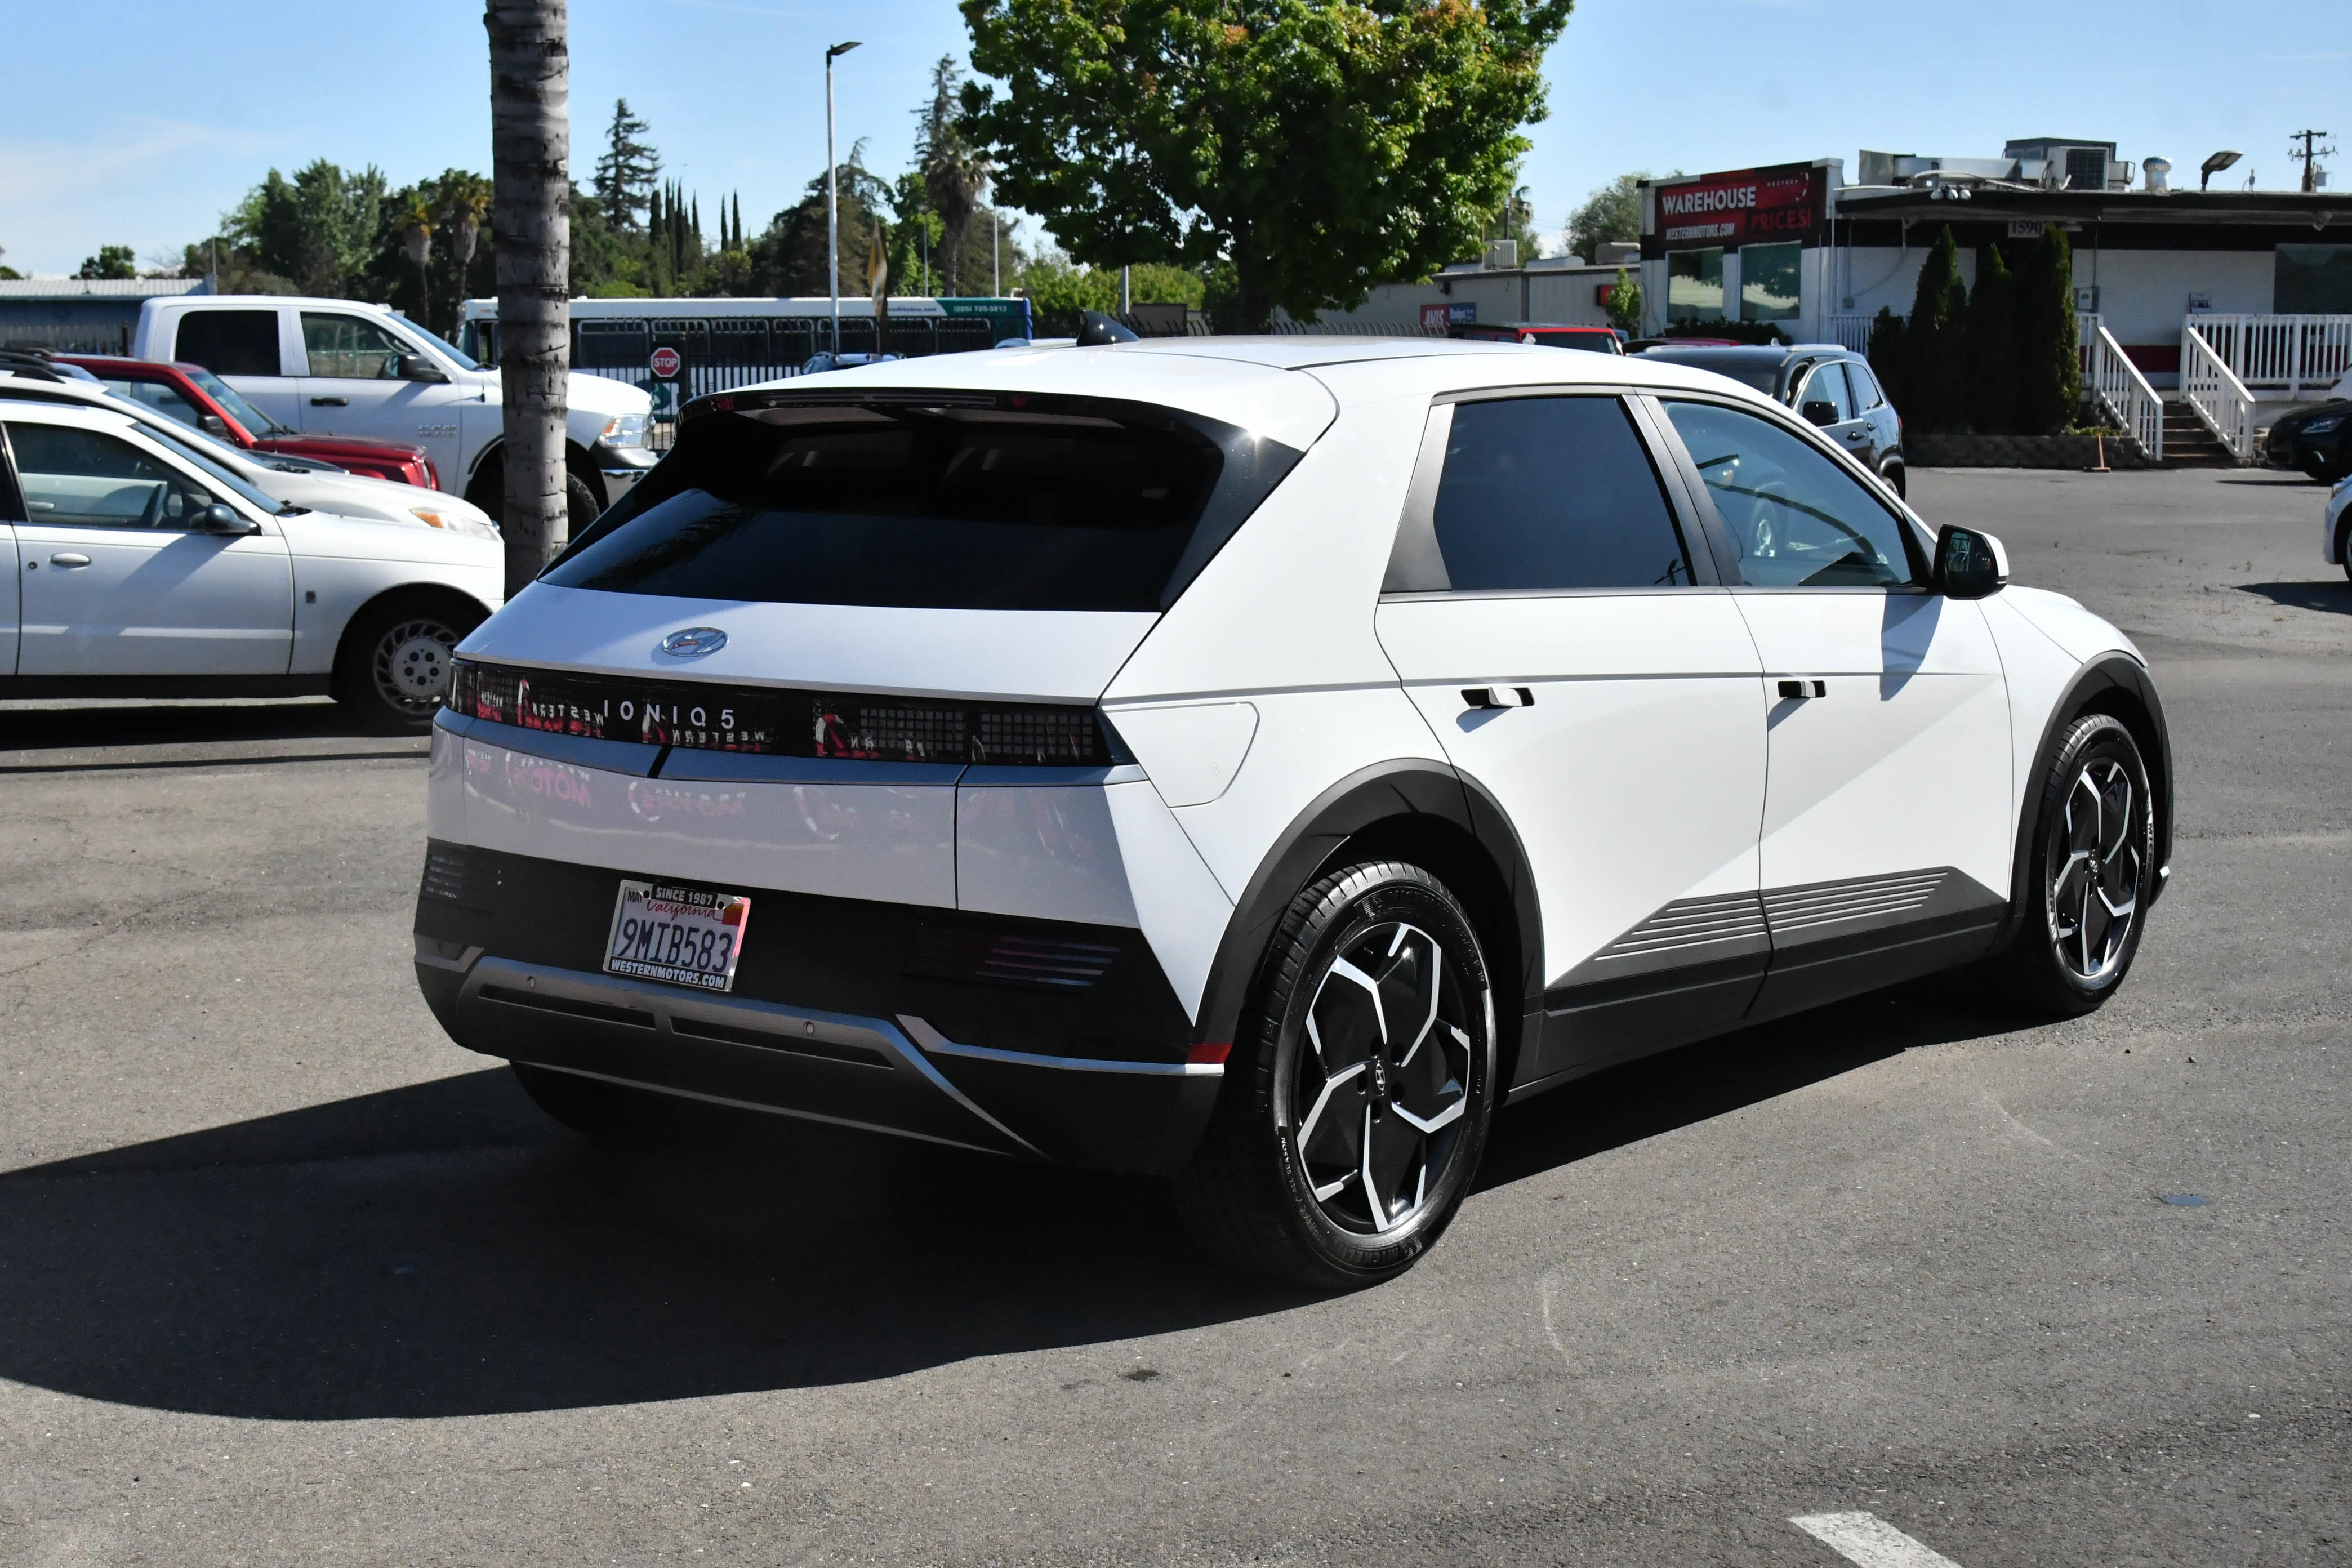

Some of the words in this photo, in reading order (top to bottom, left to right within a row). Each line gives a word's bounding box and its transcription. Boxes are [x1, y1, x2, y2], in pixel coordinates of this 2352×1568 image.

[1663, 186, 1756, 215] WAREHOUSE
[1426, 309, 1444, 326] AVIS
[654, 357, 678, 367] STOP
[721, 709, 735, 729] 5
[627, 890, 643, 903] MAY
[656, 887, 685, 902] SINCE
[688, 891, 713, 906] 1987
[646, 899, 724, 921] California
[617, 918, 732, 973] 9MIB583
[611, 959, 725, 990] WESTERNMOTORS.COM
[1281, 1136, 1293, 1176] SEASON
[1289, 1178, 1297, 1193] ALL
